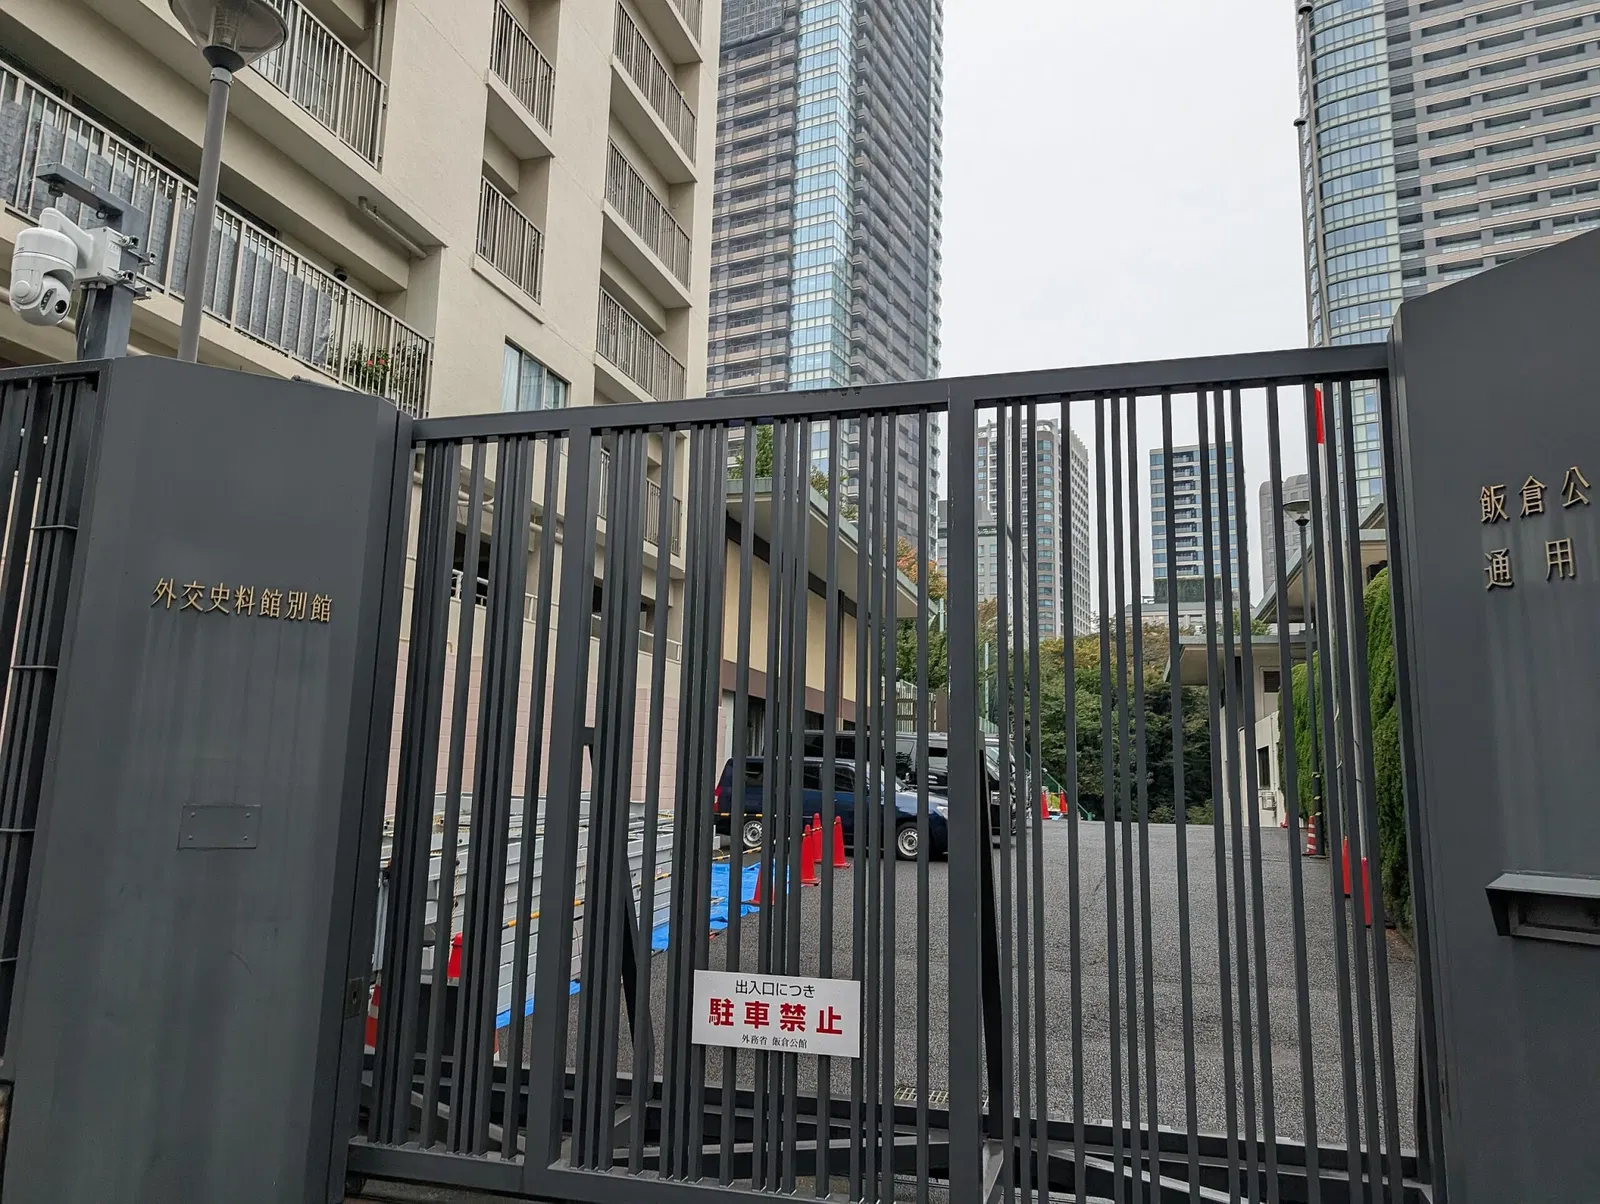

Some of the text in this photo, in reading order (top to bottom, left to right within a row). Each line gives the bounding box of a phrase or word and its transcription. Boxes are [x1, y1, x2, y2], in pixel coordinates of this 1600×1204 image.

[1479, 466, 1591, 523] 飯倉公
[1483, 537, 1576, 590] 通用
[150, 577, 333, 623] 外交史料館別館
[735, 979, 816, 998] 出入口につき
[708, 998, 843, 1035] 駐車禁止
[741, 1034, 808, 1049] 外務省 飯倉公館
